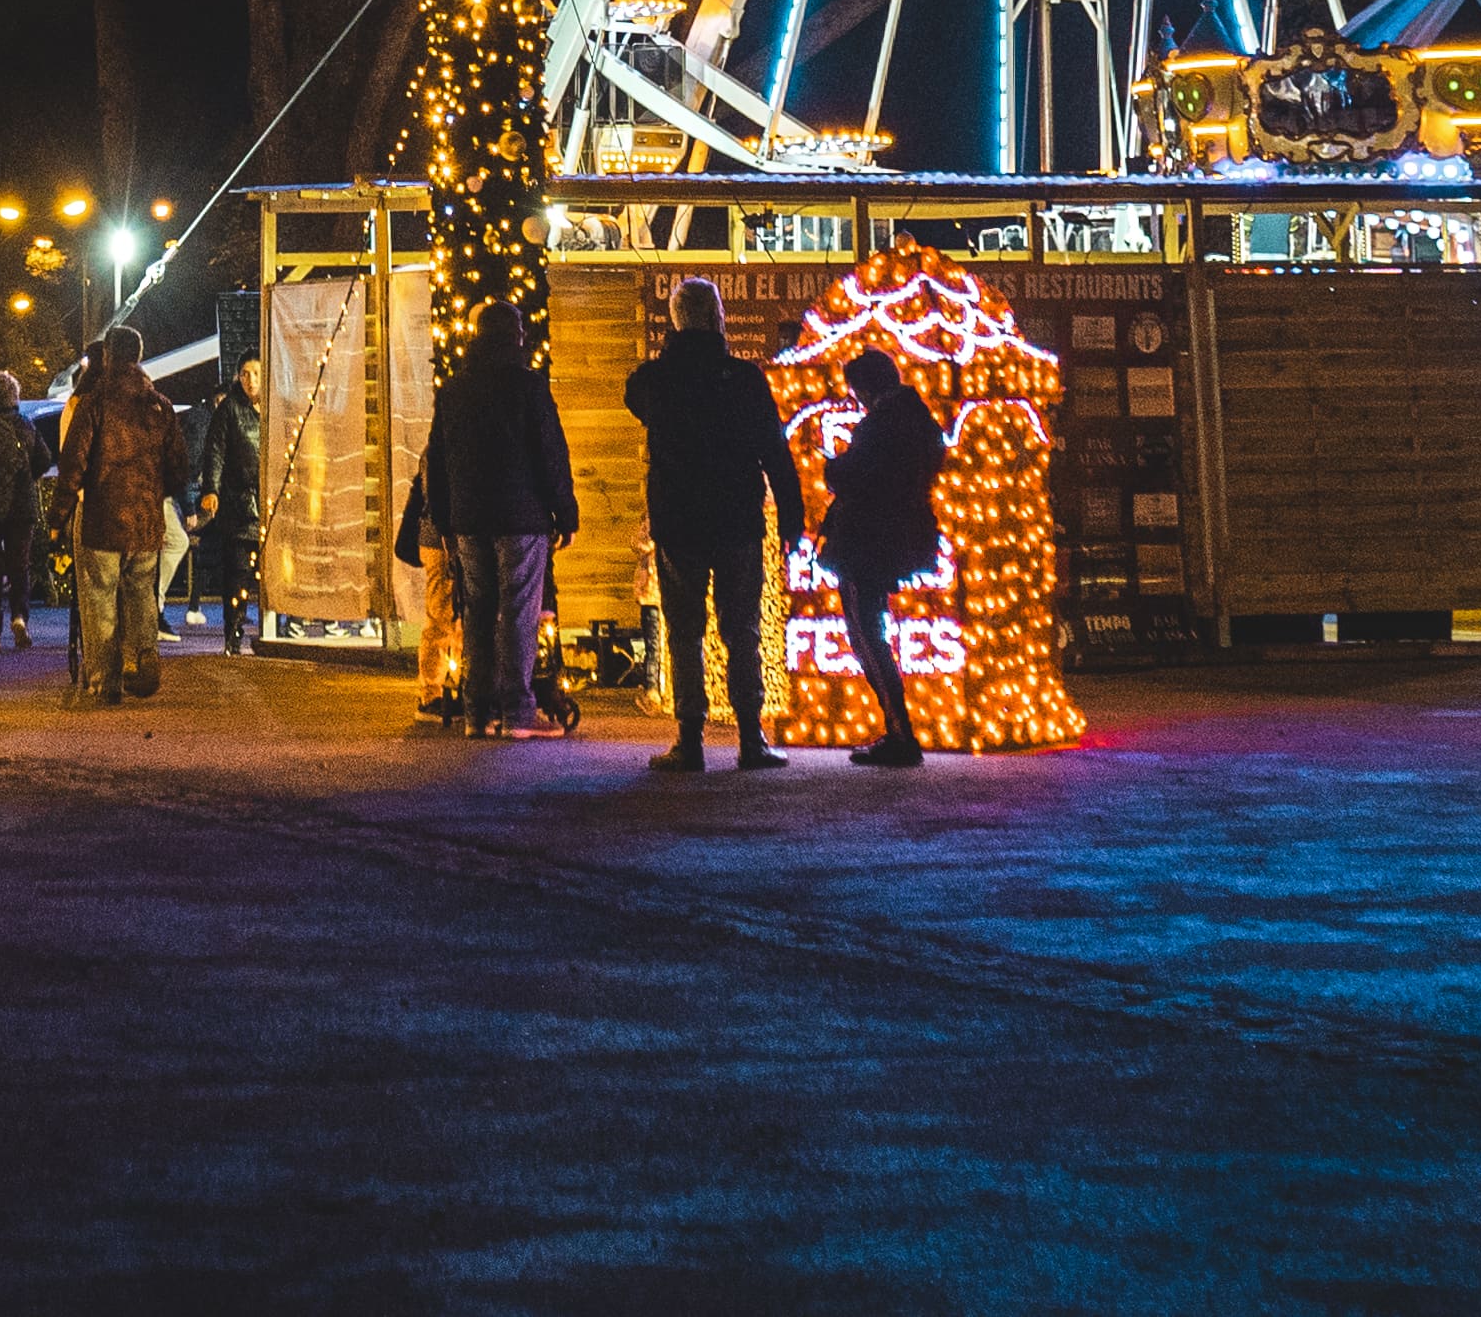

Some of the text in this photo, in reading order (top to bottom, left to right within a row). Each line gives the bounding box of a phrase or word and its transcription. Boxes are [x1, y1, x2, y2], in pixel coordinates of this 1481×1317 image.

[755, 272, 780, 300] EL
[1024, 272, 1164, 300] RESTAURANTS
[1084, 614, 1131, 632] TEMPO
[785, 615, 967, 674] FEES
